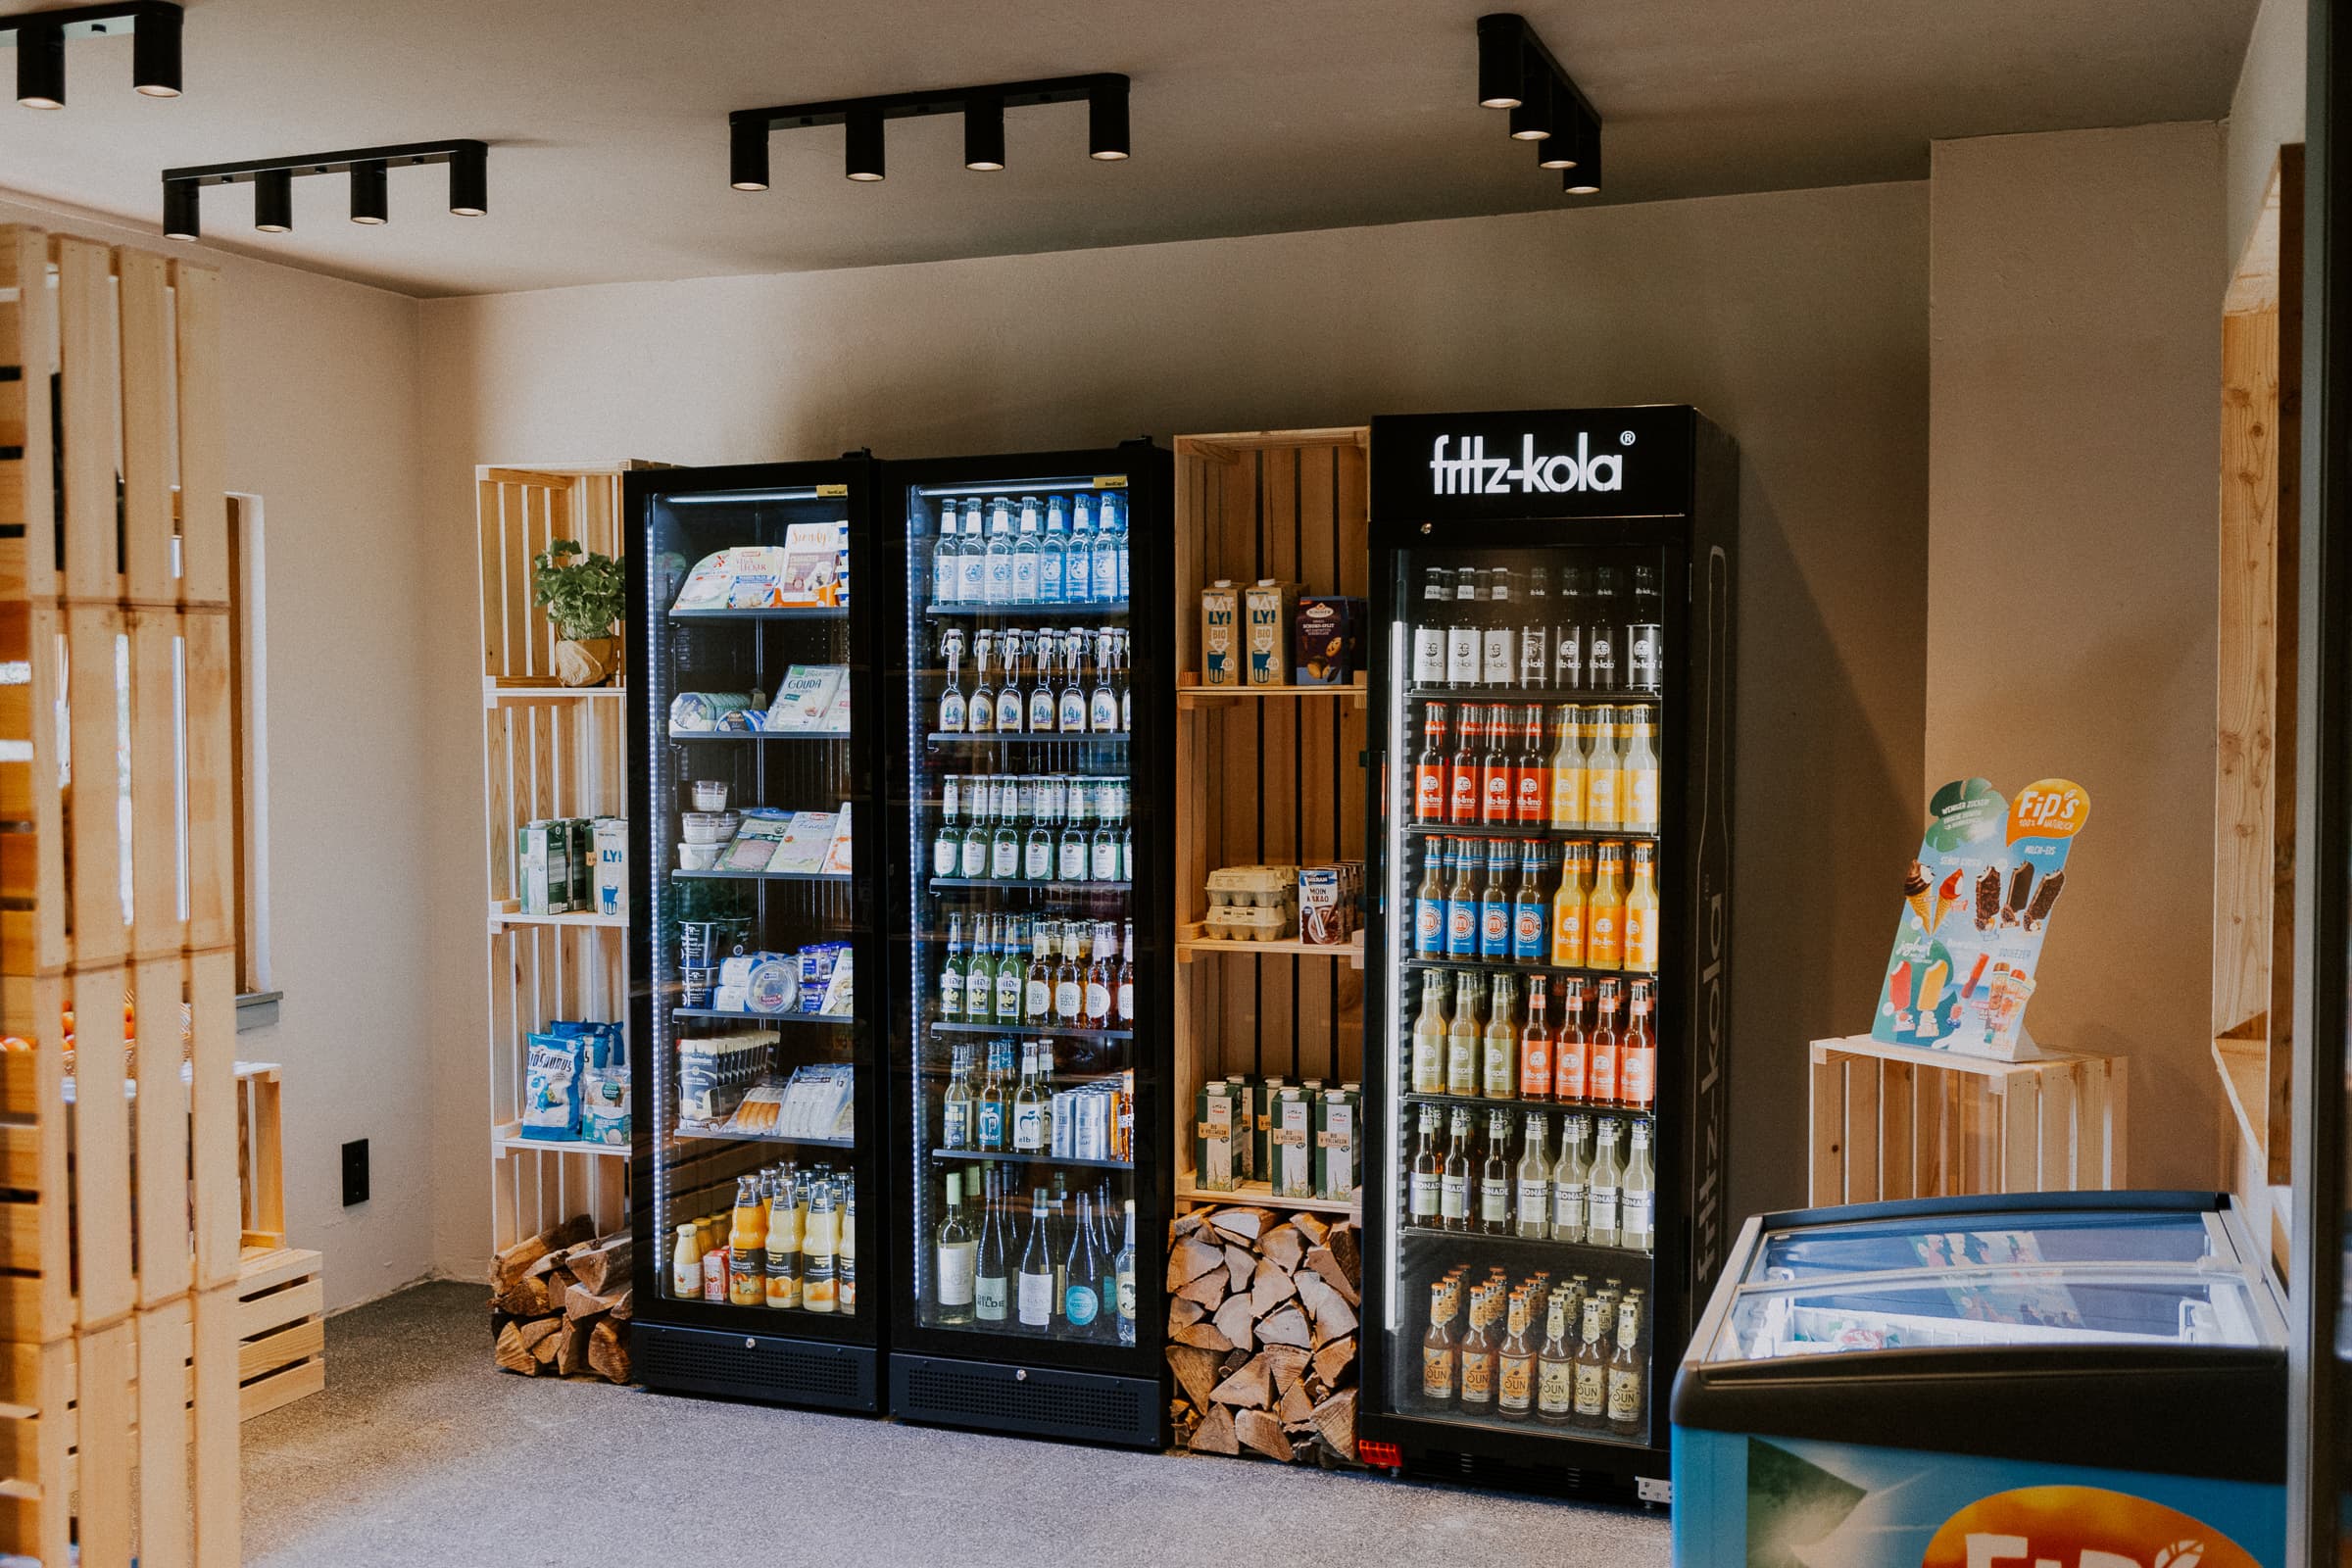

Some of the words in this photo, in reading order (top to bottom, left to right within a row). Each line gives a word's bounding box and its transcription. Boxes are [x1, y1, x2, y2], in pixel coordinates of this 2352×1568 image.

[1208, 611, 1232, 625] LY!
[1253, 610, 1276, 624] LY!
[2018, 789, 2080, 825] Fip's
[1427, 1364, 1447, 1380] SUN
[1467, 1370, 1489, 1384] SUN
[1505, 1376, 1526, 1390] SUN
[1544, 1380, 1565, 1395] SUN
[1577, 1383, 1598, 1396] SUN
[1613, 1389, 1635, 1403] SUN
